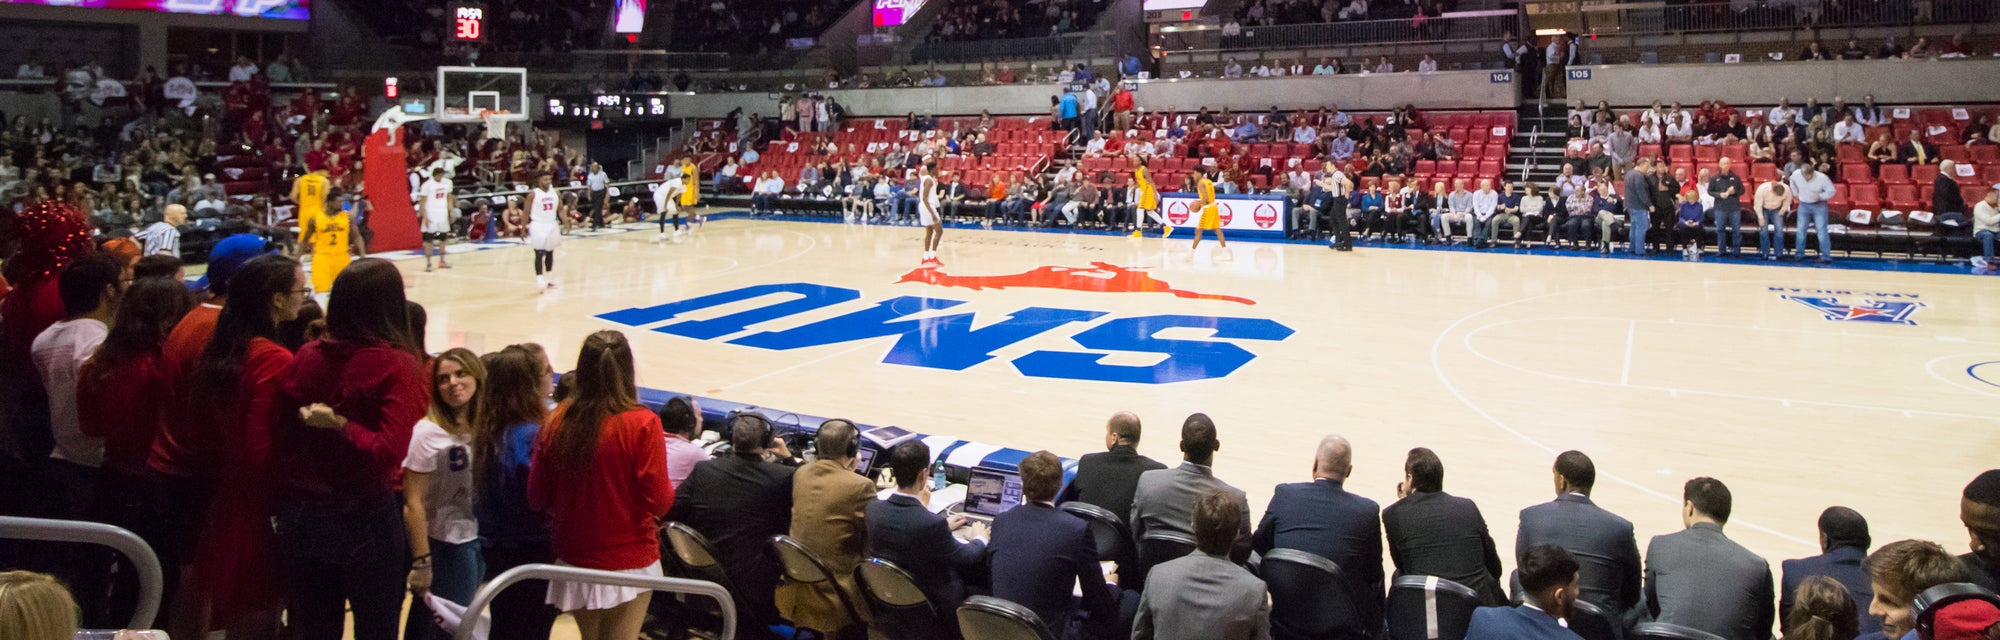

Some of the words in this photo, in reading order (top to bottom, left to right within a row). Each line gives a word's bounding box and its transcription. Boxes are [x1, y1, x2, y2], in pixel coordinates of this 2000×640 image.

[456, 18, 480, 39] 30
[1493, 73, 1509, 81] 104
[1571, 70, 1588, 78] 105
[651, 104, 664, 115] 20
[330, 234, 337, 245] 2
[591, 282, 1297, 384] SMU
